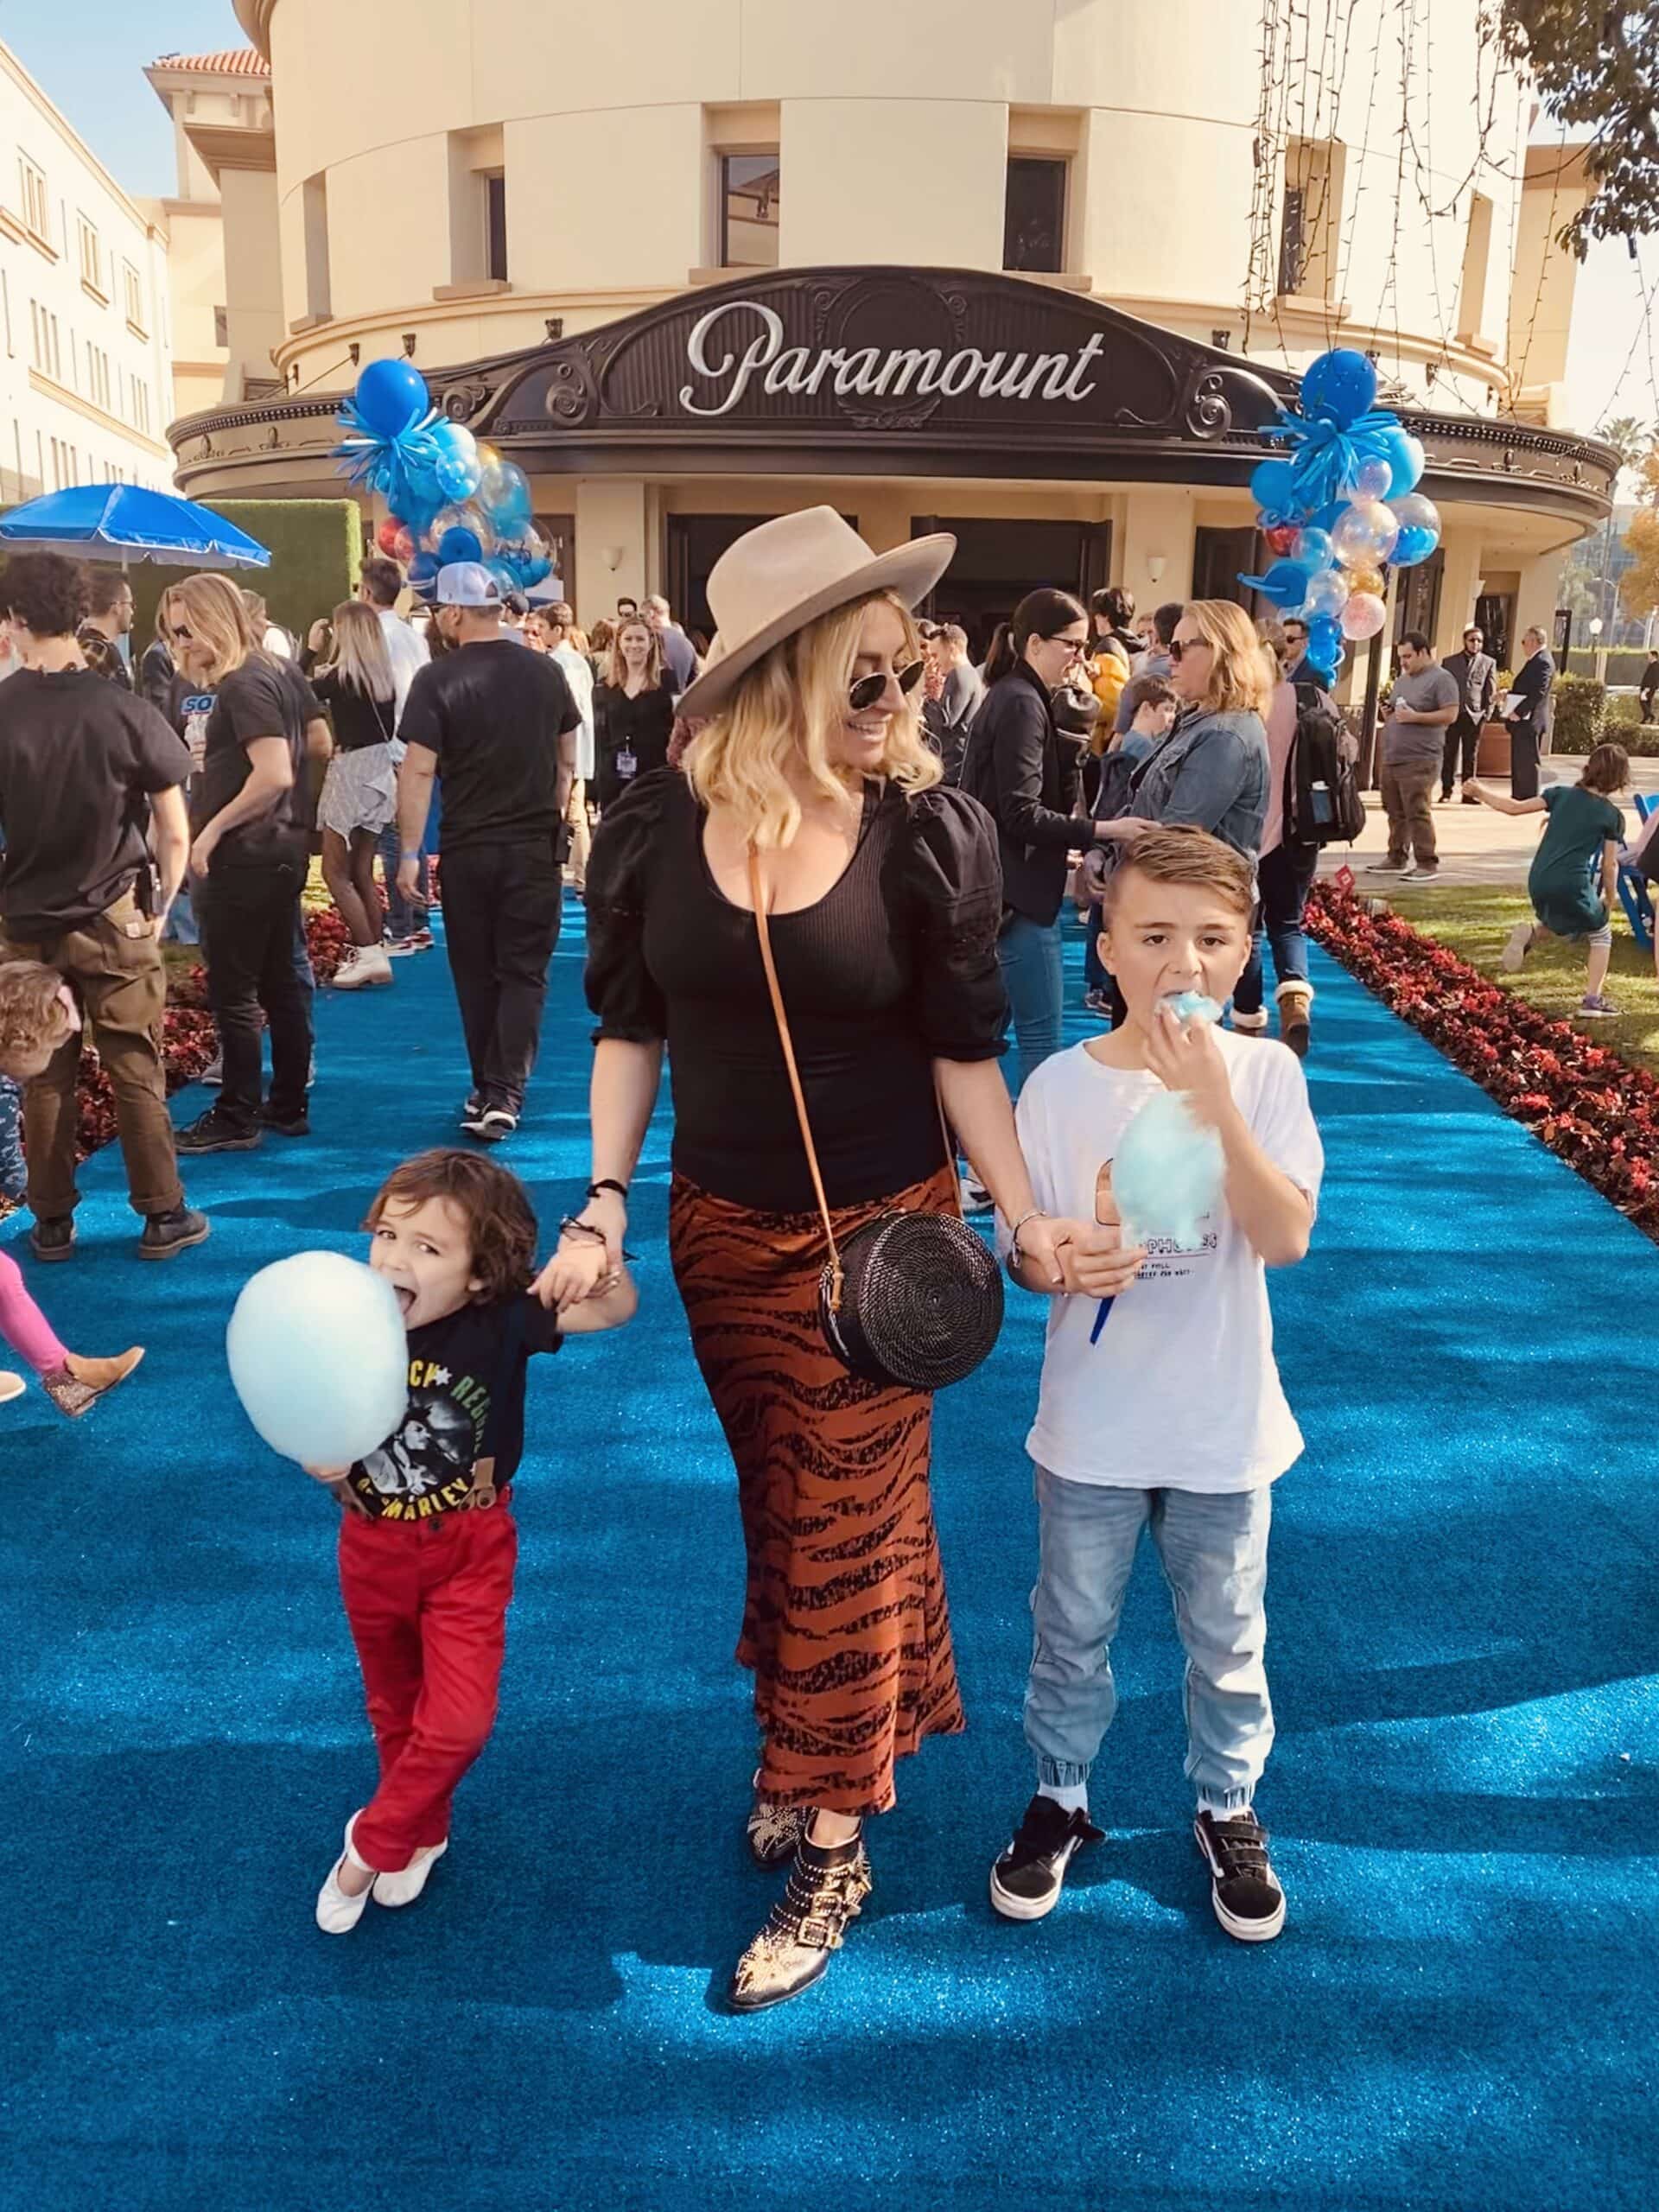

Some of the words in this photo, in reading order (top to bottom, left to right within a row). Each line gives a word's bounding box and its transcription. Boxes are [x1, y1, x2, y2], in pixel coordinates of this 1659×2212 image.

[679, 301, 1104, 416] Paramount
[409, 1359, 440, 1389] CK
[381, 1478, 469, 1521] MARLEY
